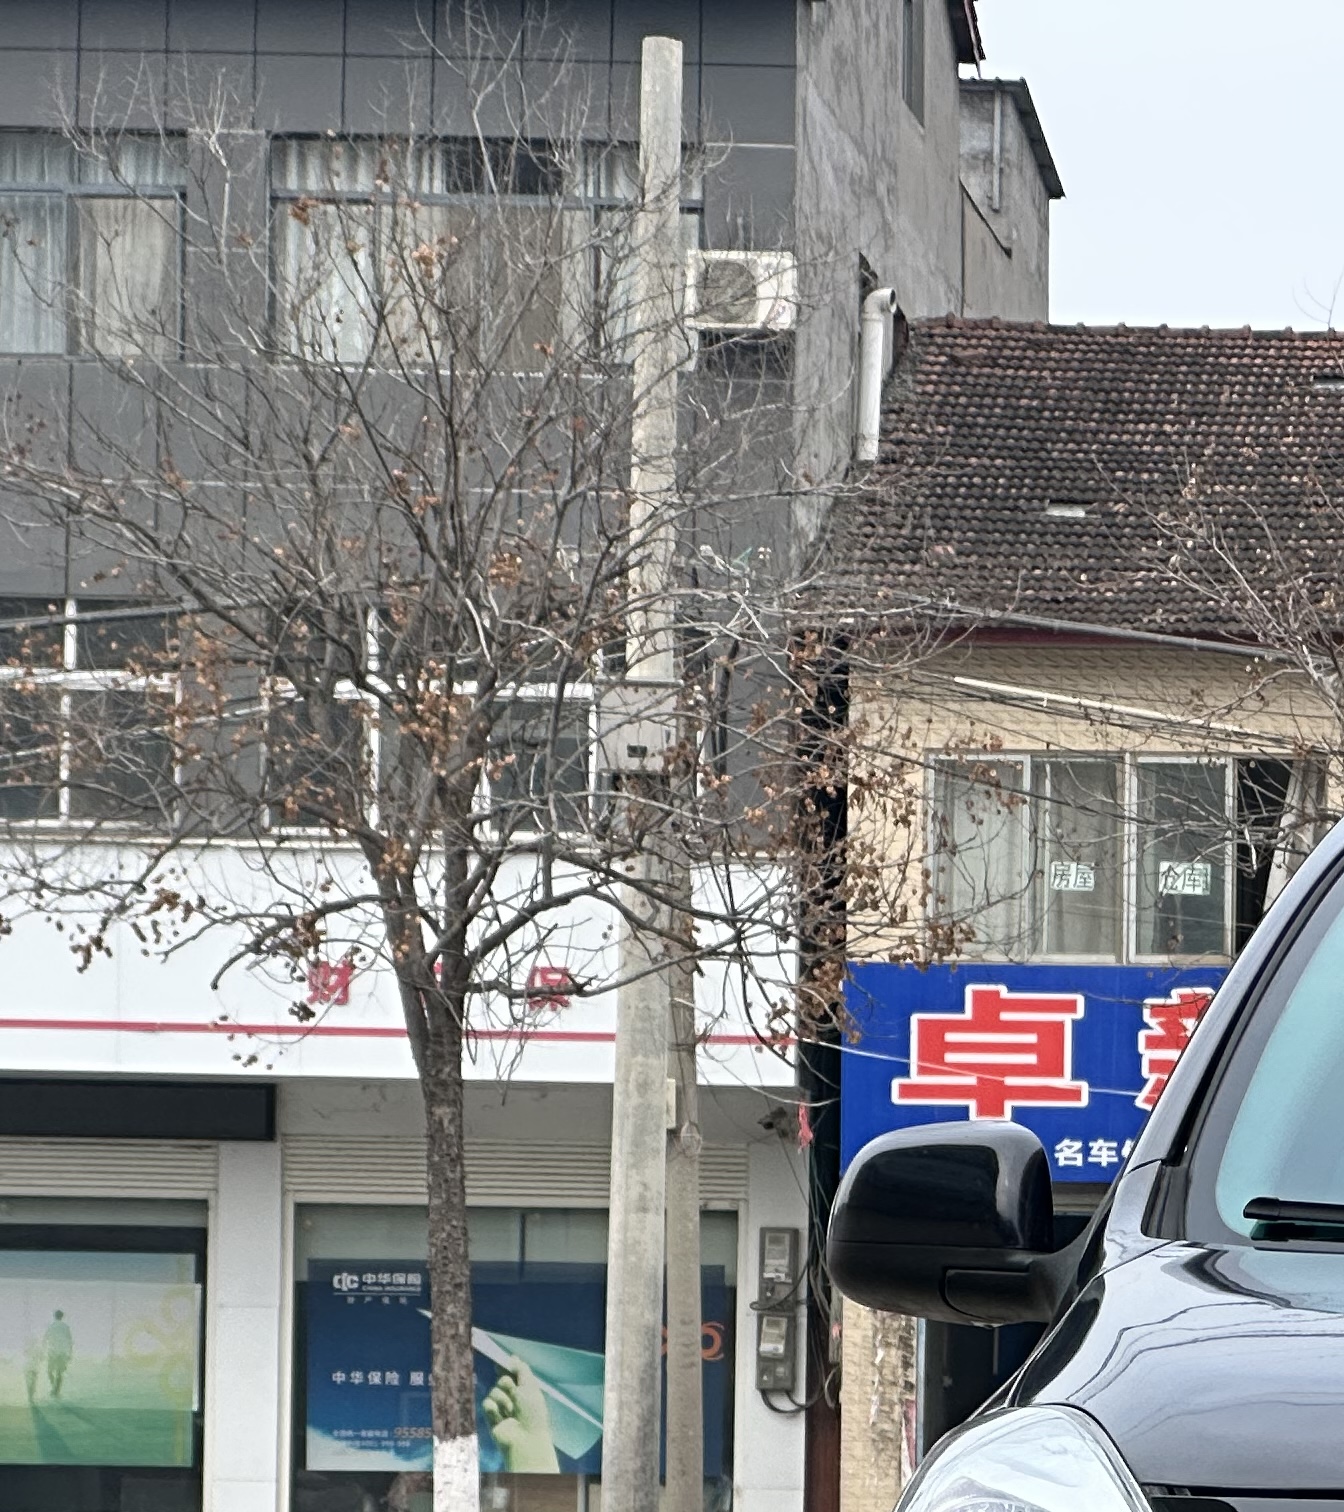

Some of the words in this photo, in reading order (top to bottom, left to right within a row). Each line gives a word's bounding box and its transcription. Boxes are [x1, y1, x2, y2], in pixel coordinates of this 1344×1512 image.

[1053, 863, 1095, 889] 房屋
[1054, 1139, 1135, 1167] 名车
[332, 1371, 400, 1386] 中华保险
